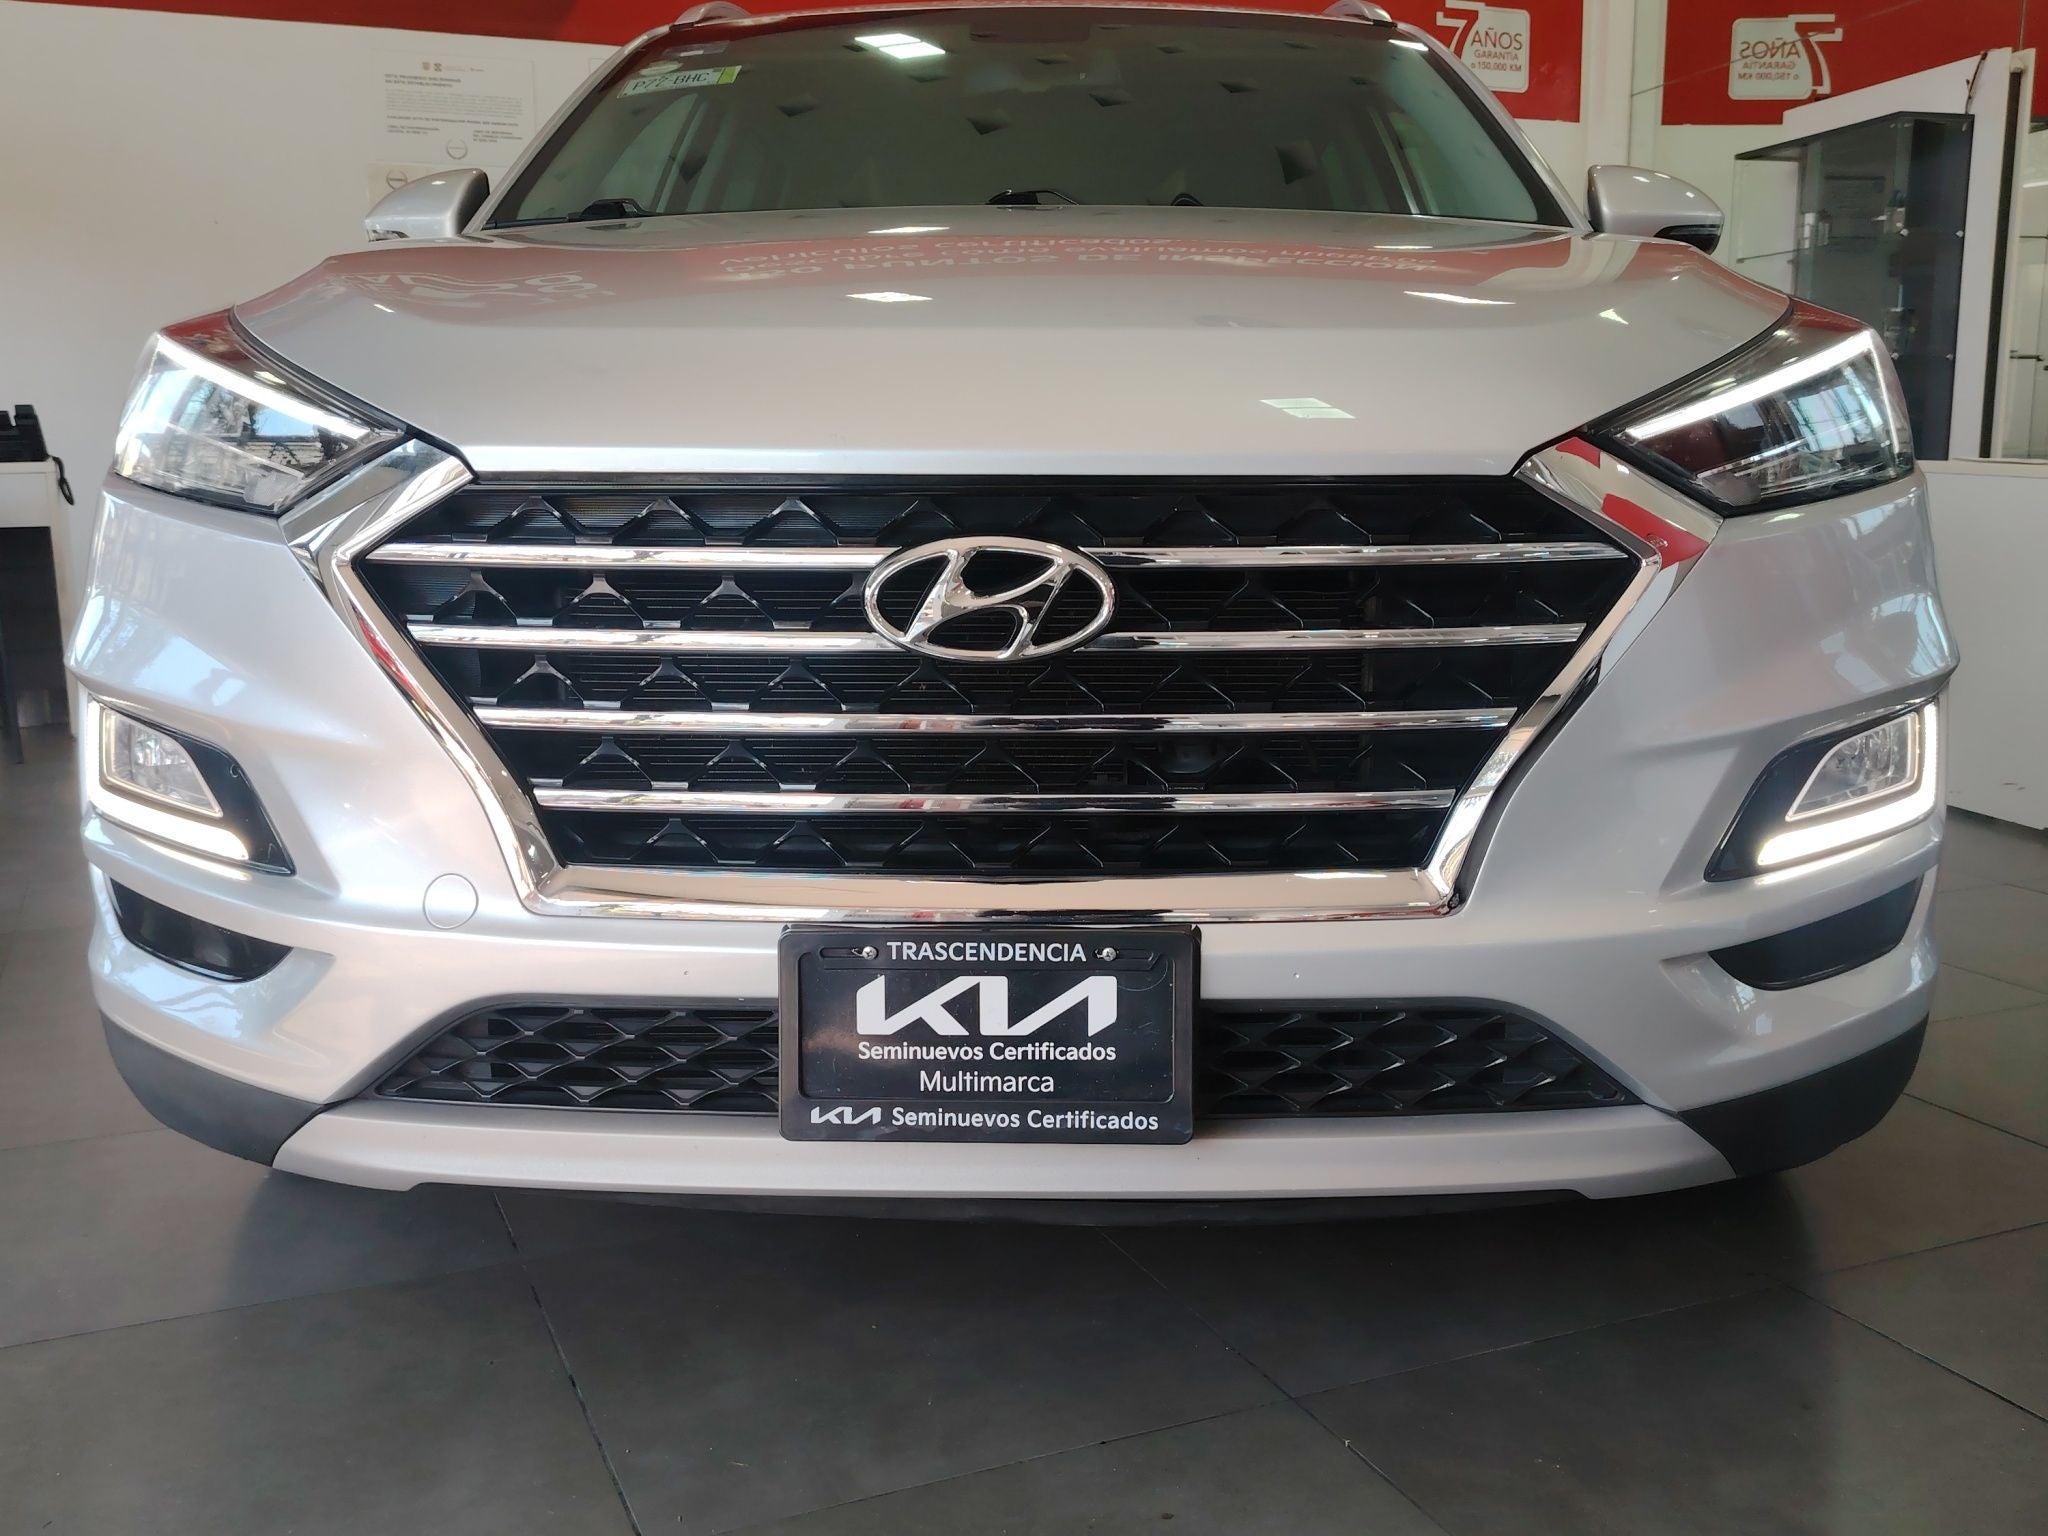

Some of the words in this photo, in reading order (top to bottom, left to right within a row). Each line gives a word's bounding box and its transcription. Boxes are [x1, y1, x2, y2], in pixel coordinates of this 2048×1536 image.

[1437, 0, 1479, 59] 7
[1470, 27, 1523, 50] AÑOS
[1509, 63, 1522, 72] KM
[887, 941, 1087, 962] TRASCENDENCIA
[856, 974, 1118, 1037] KIA
[858, 1041, 984, 1060] Seminuevos
[989, 1042, 1117, 1061] Certificados
[920, 1070, 1054, 1092] Multimarca
[810, 1106, 882, 1125] KIA
[892, 1107, 1020, 1128] Seminuevos
[1027, 1109, 1159, 1130] Certificados
